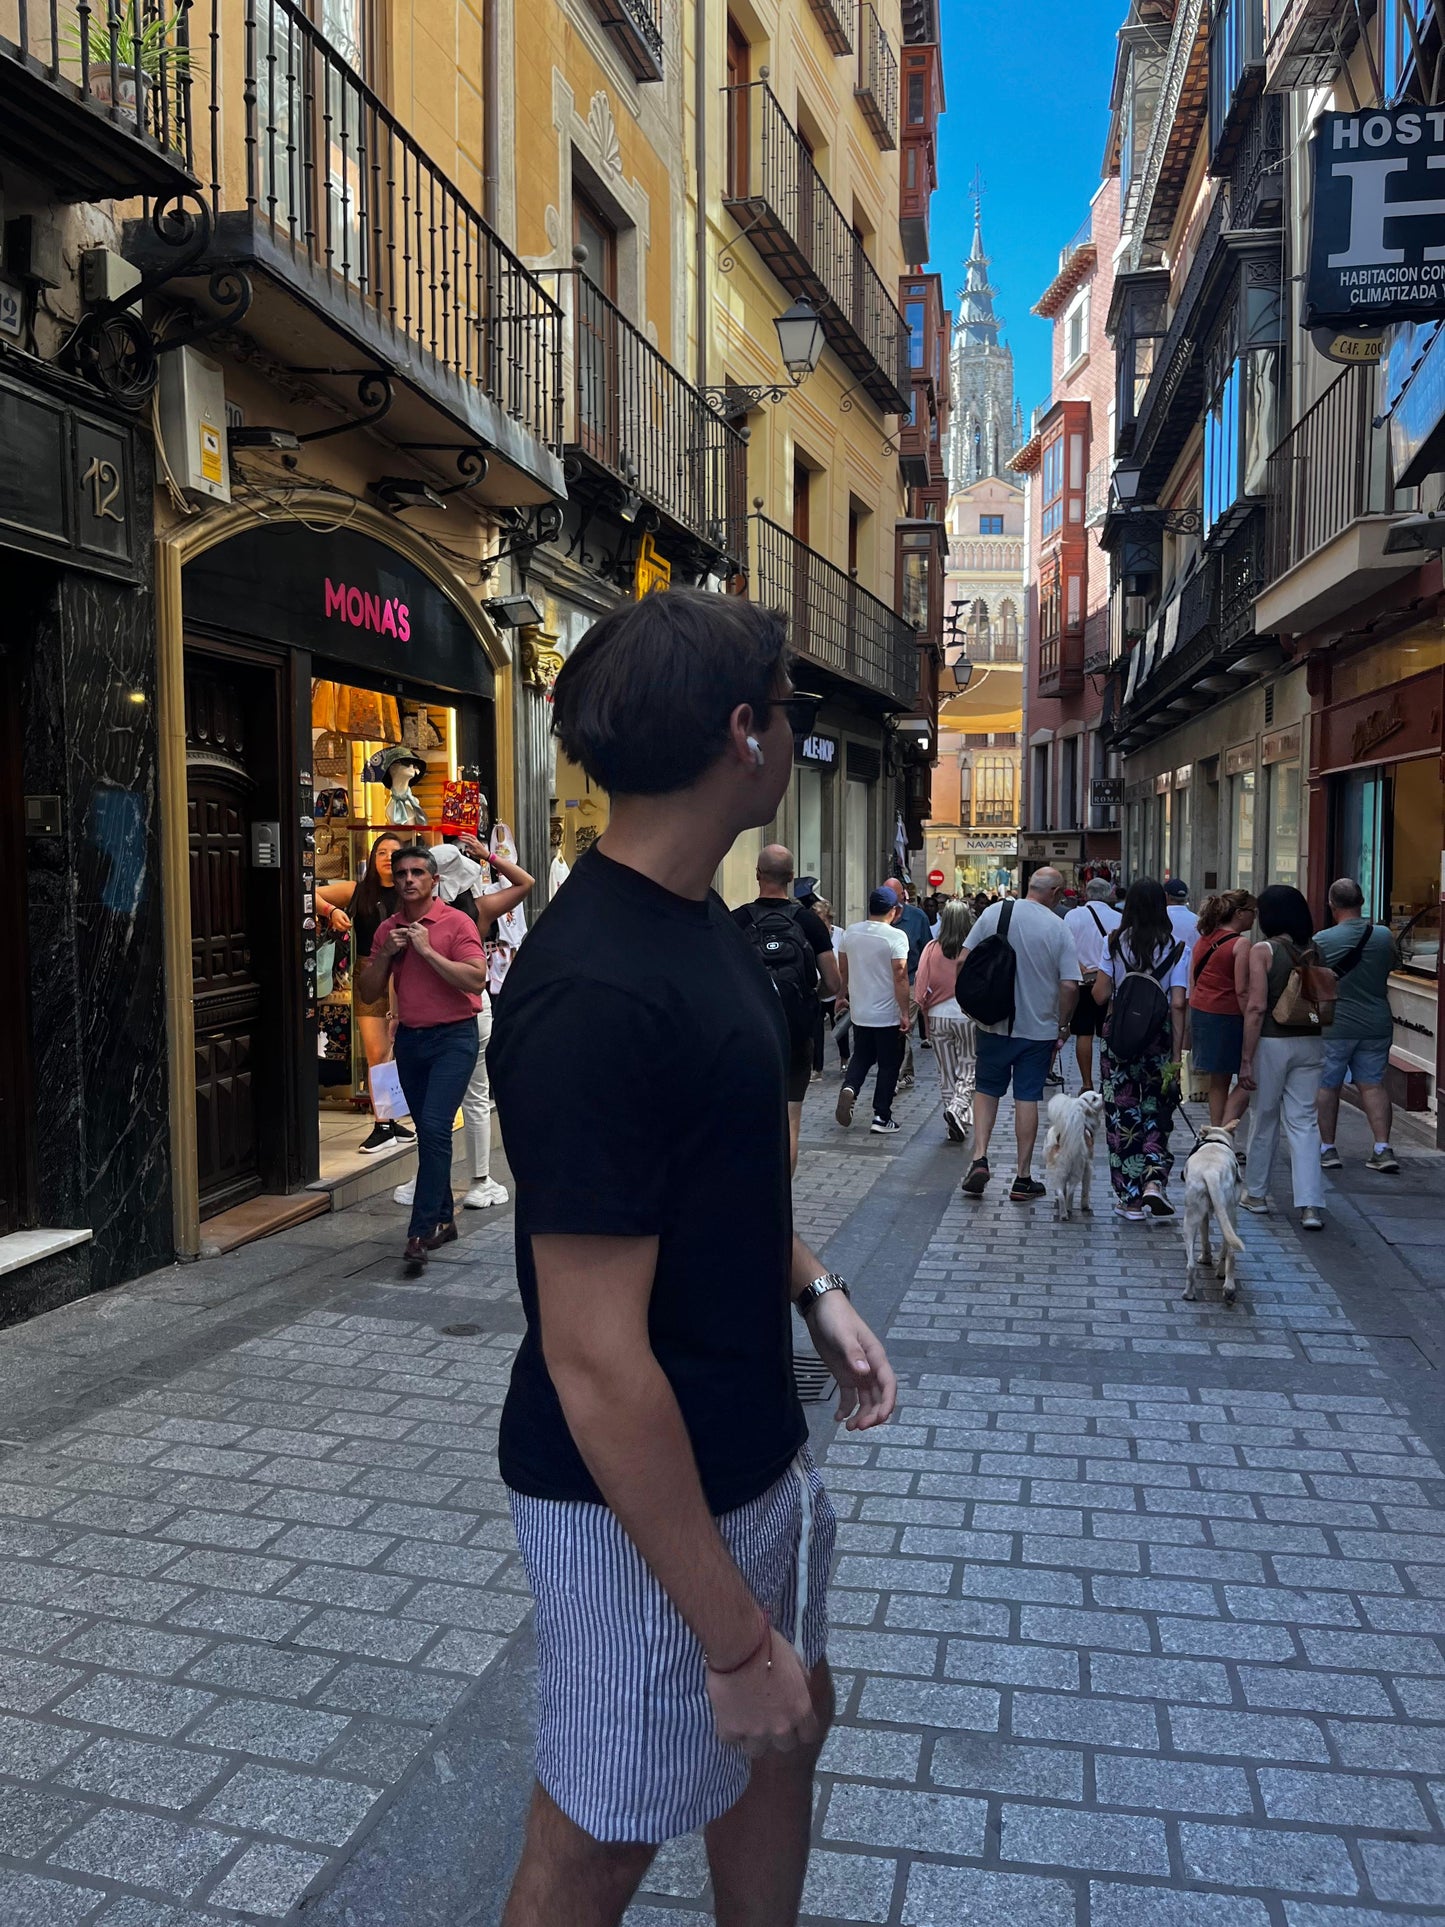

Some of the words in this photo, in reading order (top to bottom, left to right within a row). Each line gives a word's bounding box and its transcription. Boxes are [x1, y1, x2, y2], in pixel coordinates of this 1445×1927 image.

[1332, 111, 1445, 149] HOST
[1340, 266, 1418, 287] HABITACION
[1350, 284, 1437, 304] CLIMATIZADA
[80, 456, 125, 523] 12
[324, 577, 411, 642] MONA'S
[802, 736, 835, 763] ALE-HOP
